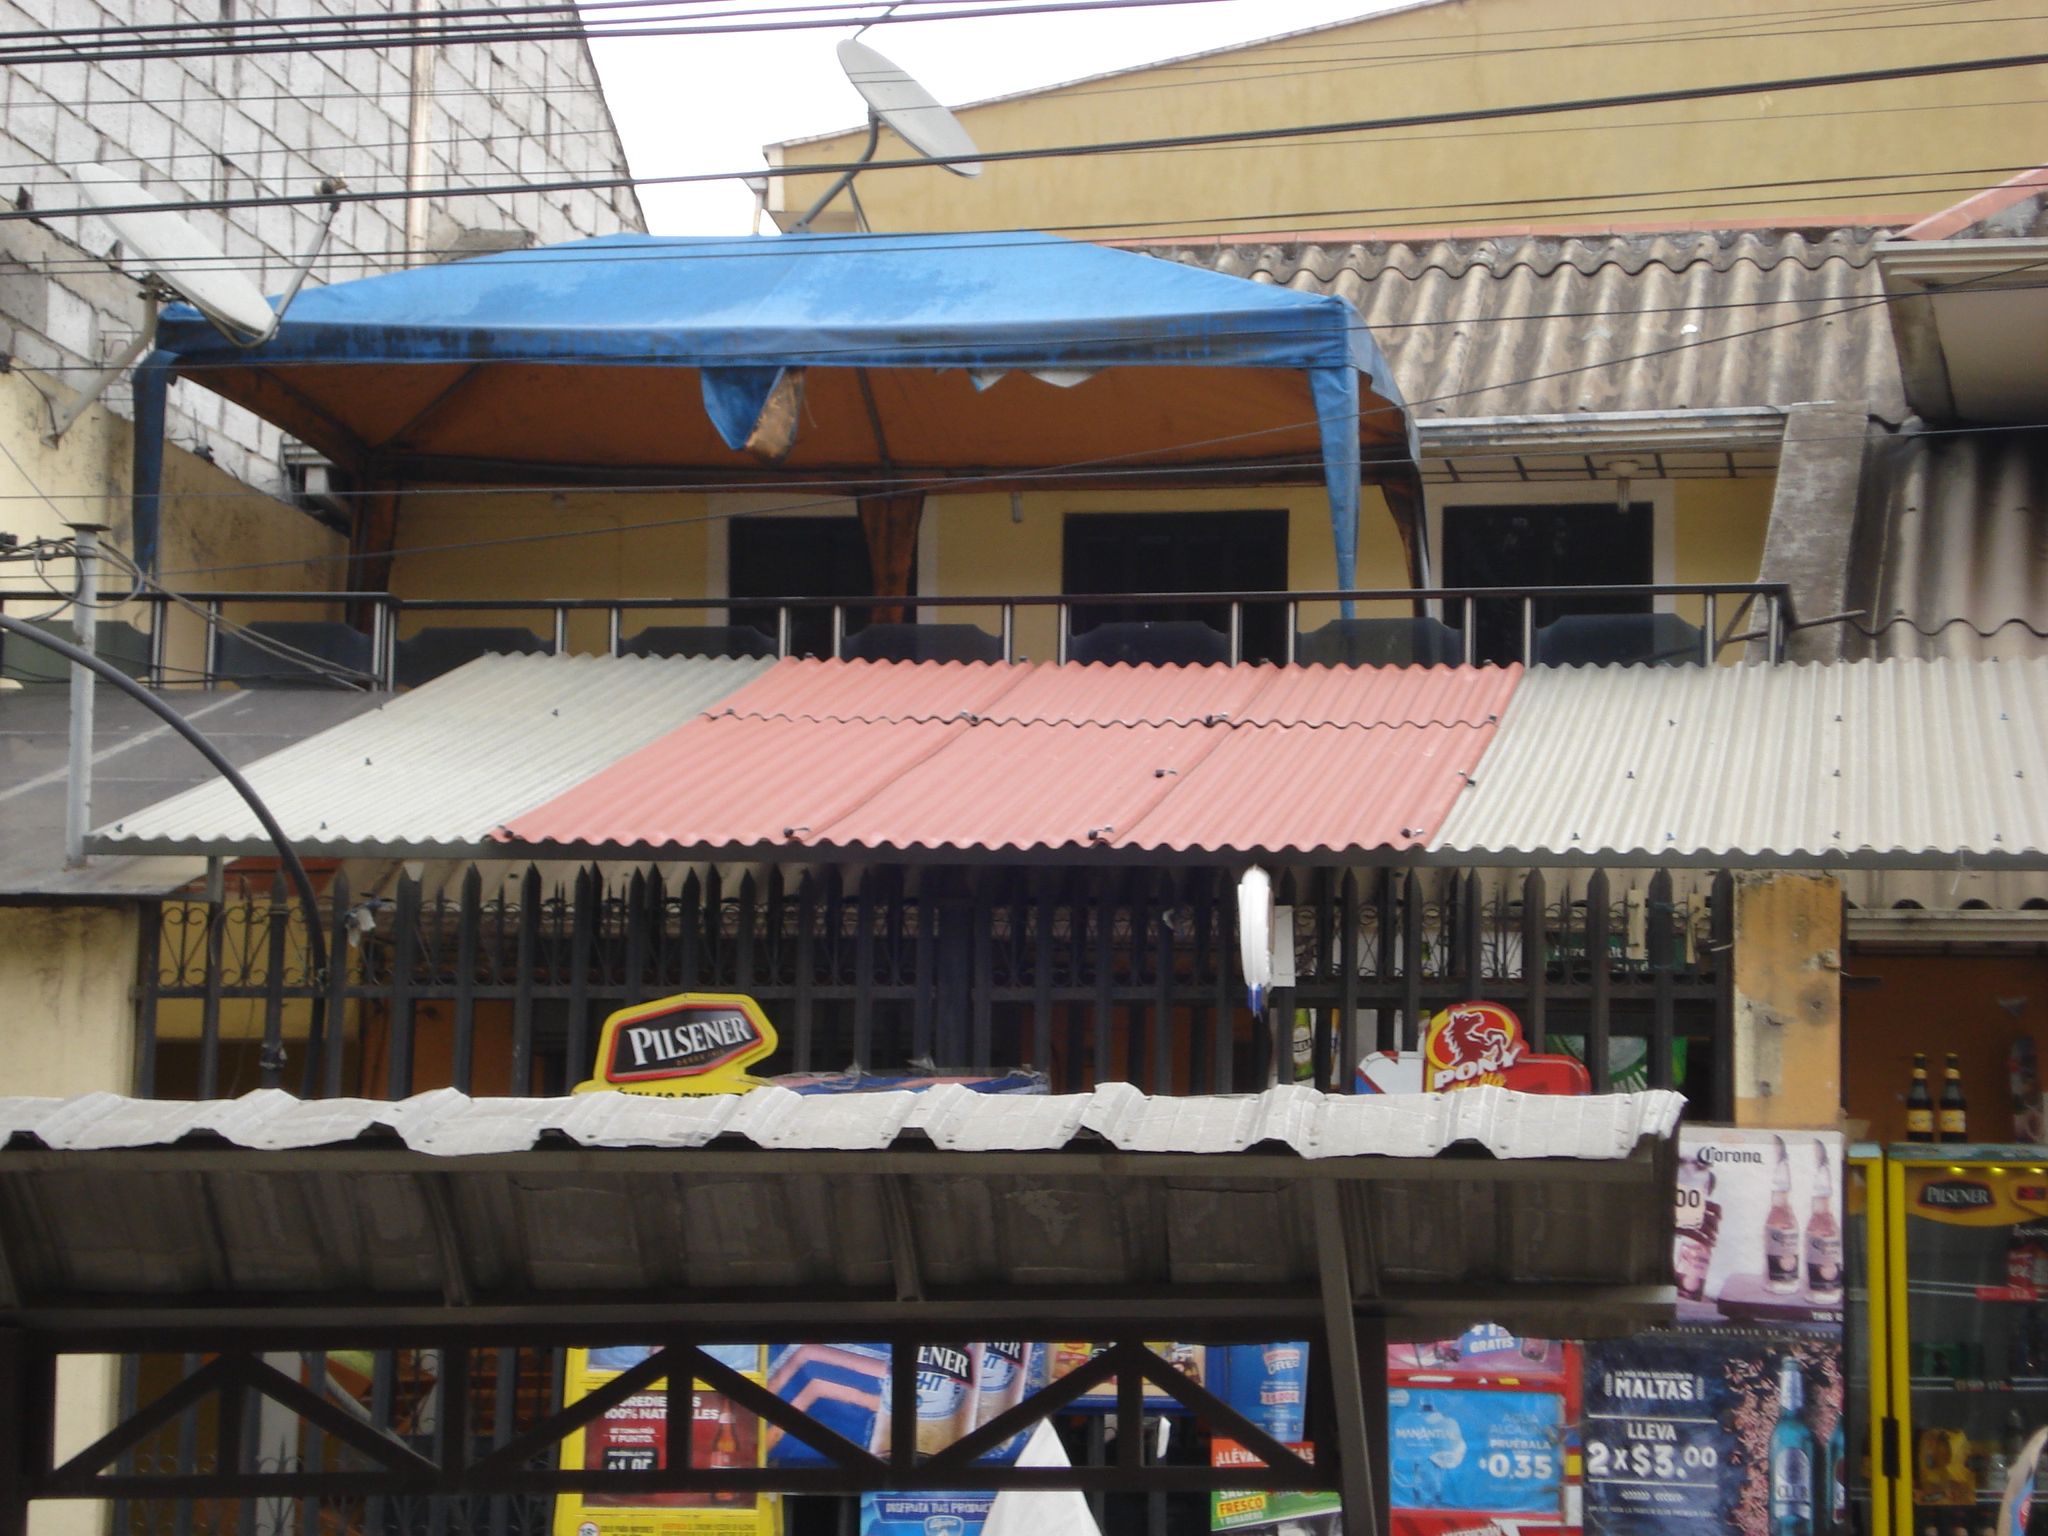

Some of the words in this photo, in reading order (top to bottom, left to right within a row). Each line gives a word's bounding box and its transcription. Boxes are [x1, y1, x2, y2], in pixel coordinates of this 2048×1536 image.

[627, 1017, 751, 1066] PILSENER
[1433, 1043, 1524, 1089] PONY
[1697, 1146, 1765, 1167] Corona
[1926, 1187, 1988, 1204] PILSENER
[1470, 1337, 1515, 1353] GRATIS
[917, 1345, 969, 1378] ENER
[1267, 1358, 1300, 1375] OREO
[1615, 1378, 1695, 1401] MALTAS
[640, 1408, 719, 1420] NATLES
[1626, 1422, 1678, 1441] LLEVA
[1219, 1497, 1263, 1515] FRESCO
